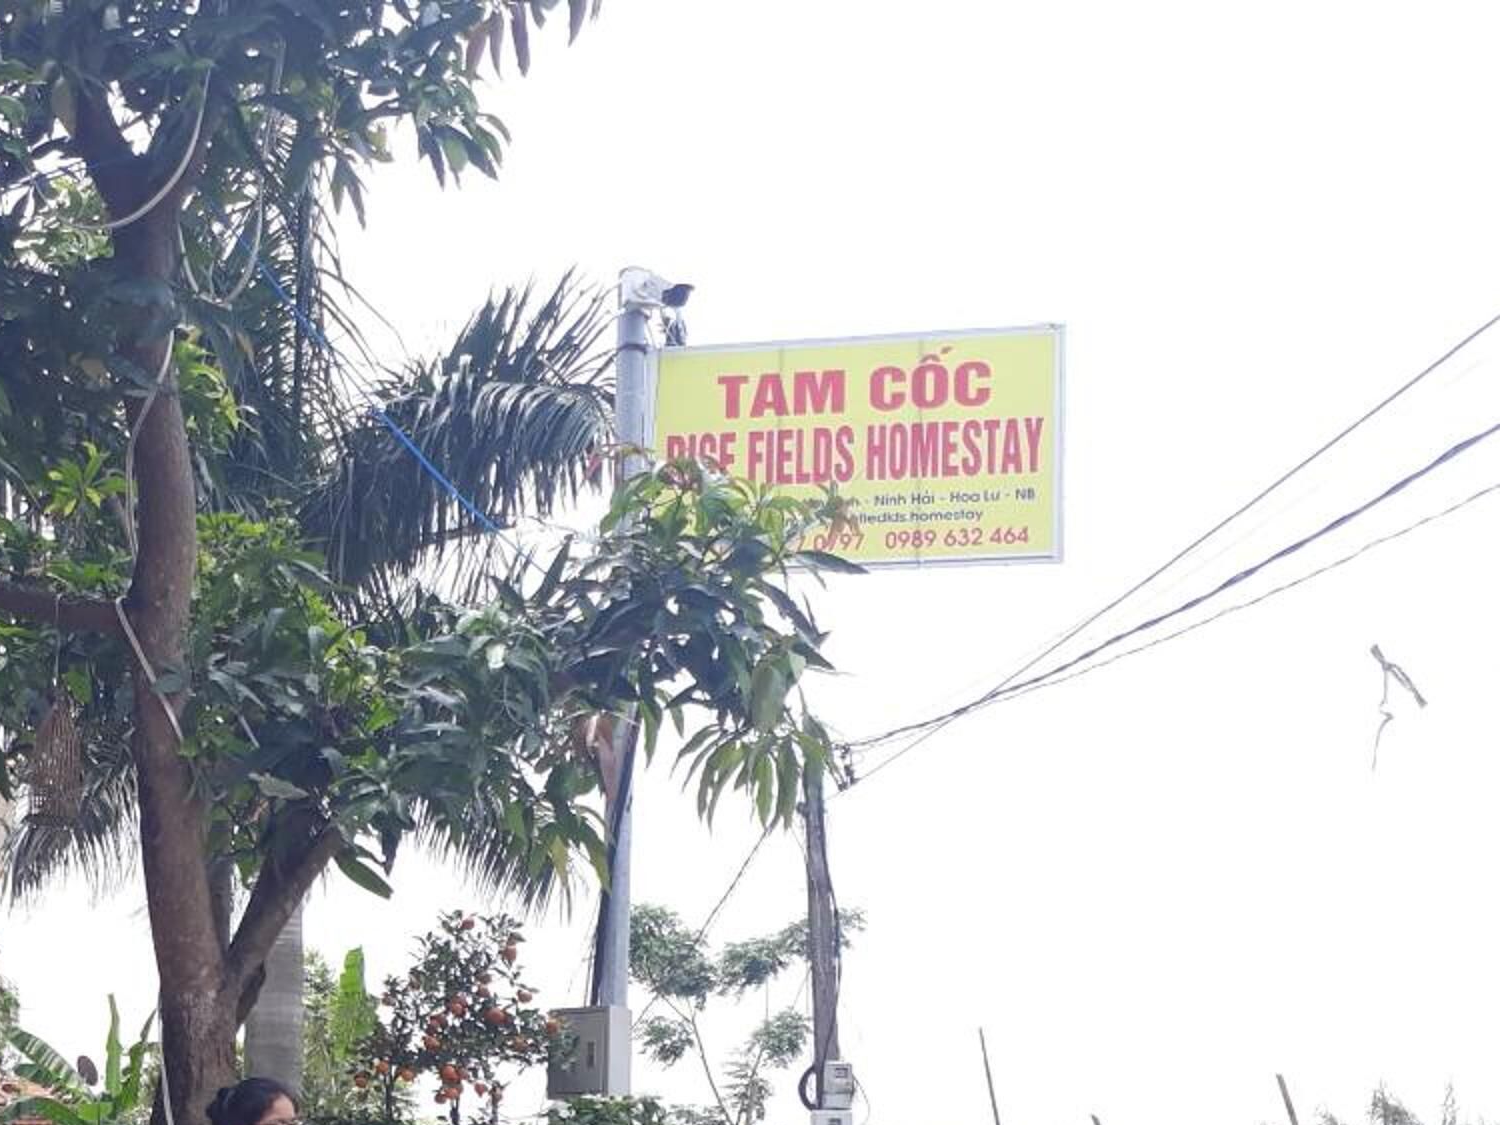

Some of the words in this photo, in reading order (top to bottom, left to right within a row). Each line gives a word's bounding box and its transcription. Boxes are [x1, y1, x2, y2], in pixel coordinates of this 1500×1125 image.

[717, 369, 846, 420] TAM
[868, 347, 992, 413] CỐC
[747, 424, 856, 486] FIELDS
[866, 417, 1045, 481] HOMESTAY
[873, 493, 907, 507] Ninh
[949, 491, 981, 503] Hoa
[1015, 487, 1035, 500] NB
[885, 529, 937, 550] 0989
[943, 528, 983, 548] 632
[990, 525, 1030, 545] 464
